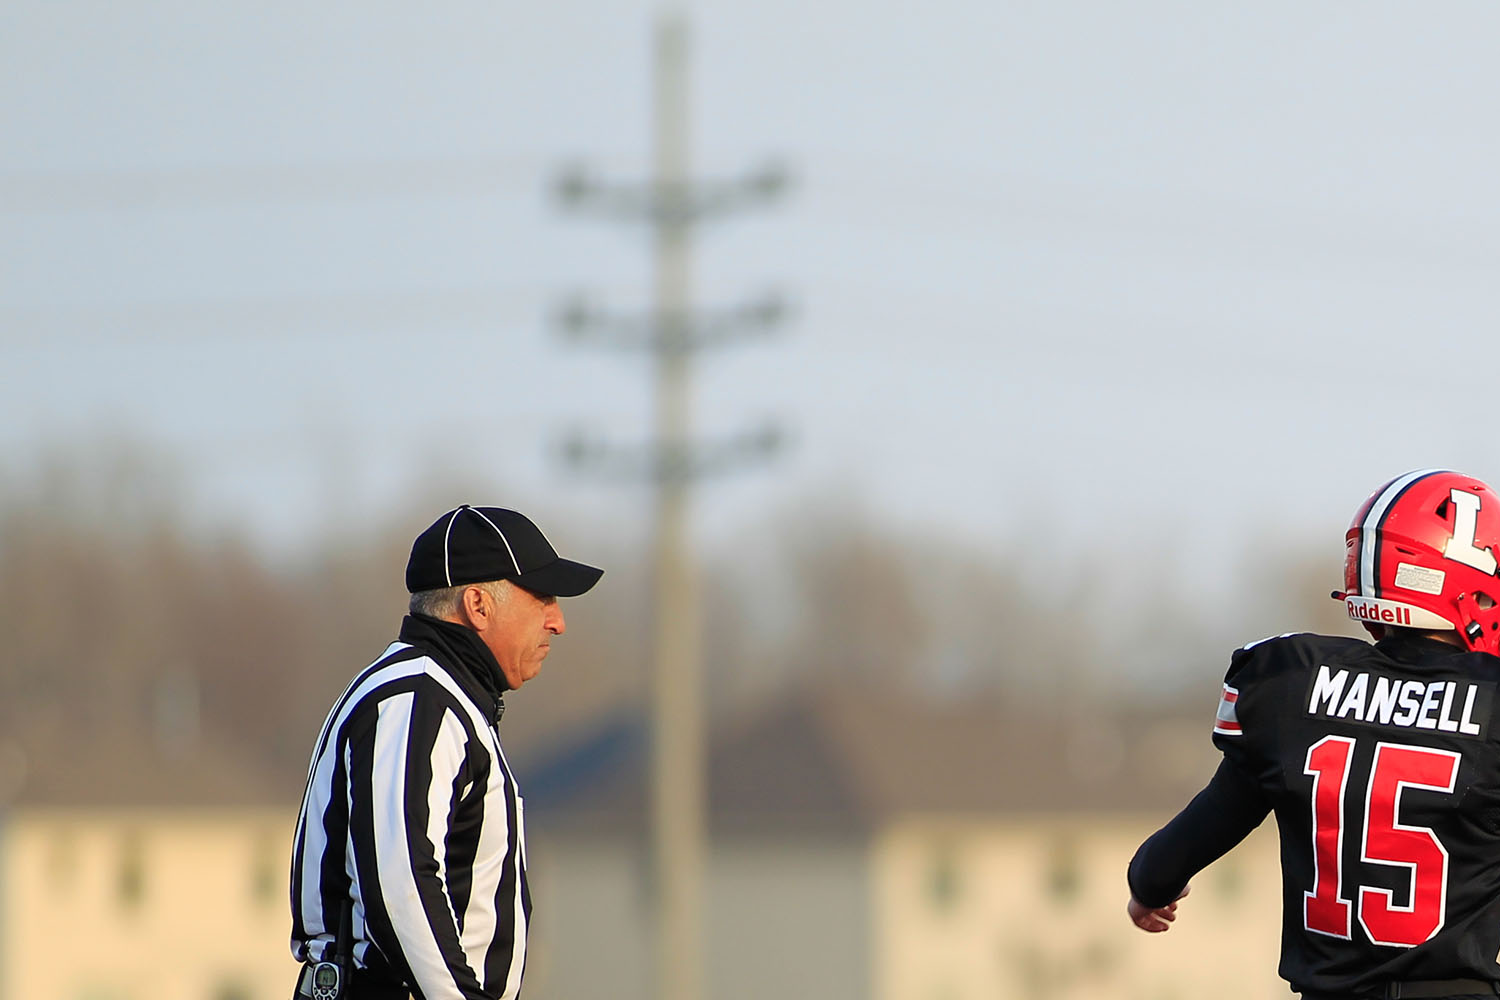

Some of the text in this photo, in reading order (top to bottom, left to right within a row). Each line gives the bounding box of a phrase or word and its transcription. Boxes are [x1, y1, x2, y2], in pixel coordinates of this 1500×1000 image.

[1443, 487, 1498, 576] L
[1347, 600, 1411, 625] Riddell
[1307, 665, 1480, 735] MANSELL
[1303, 735, 1462, 948] 15
